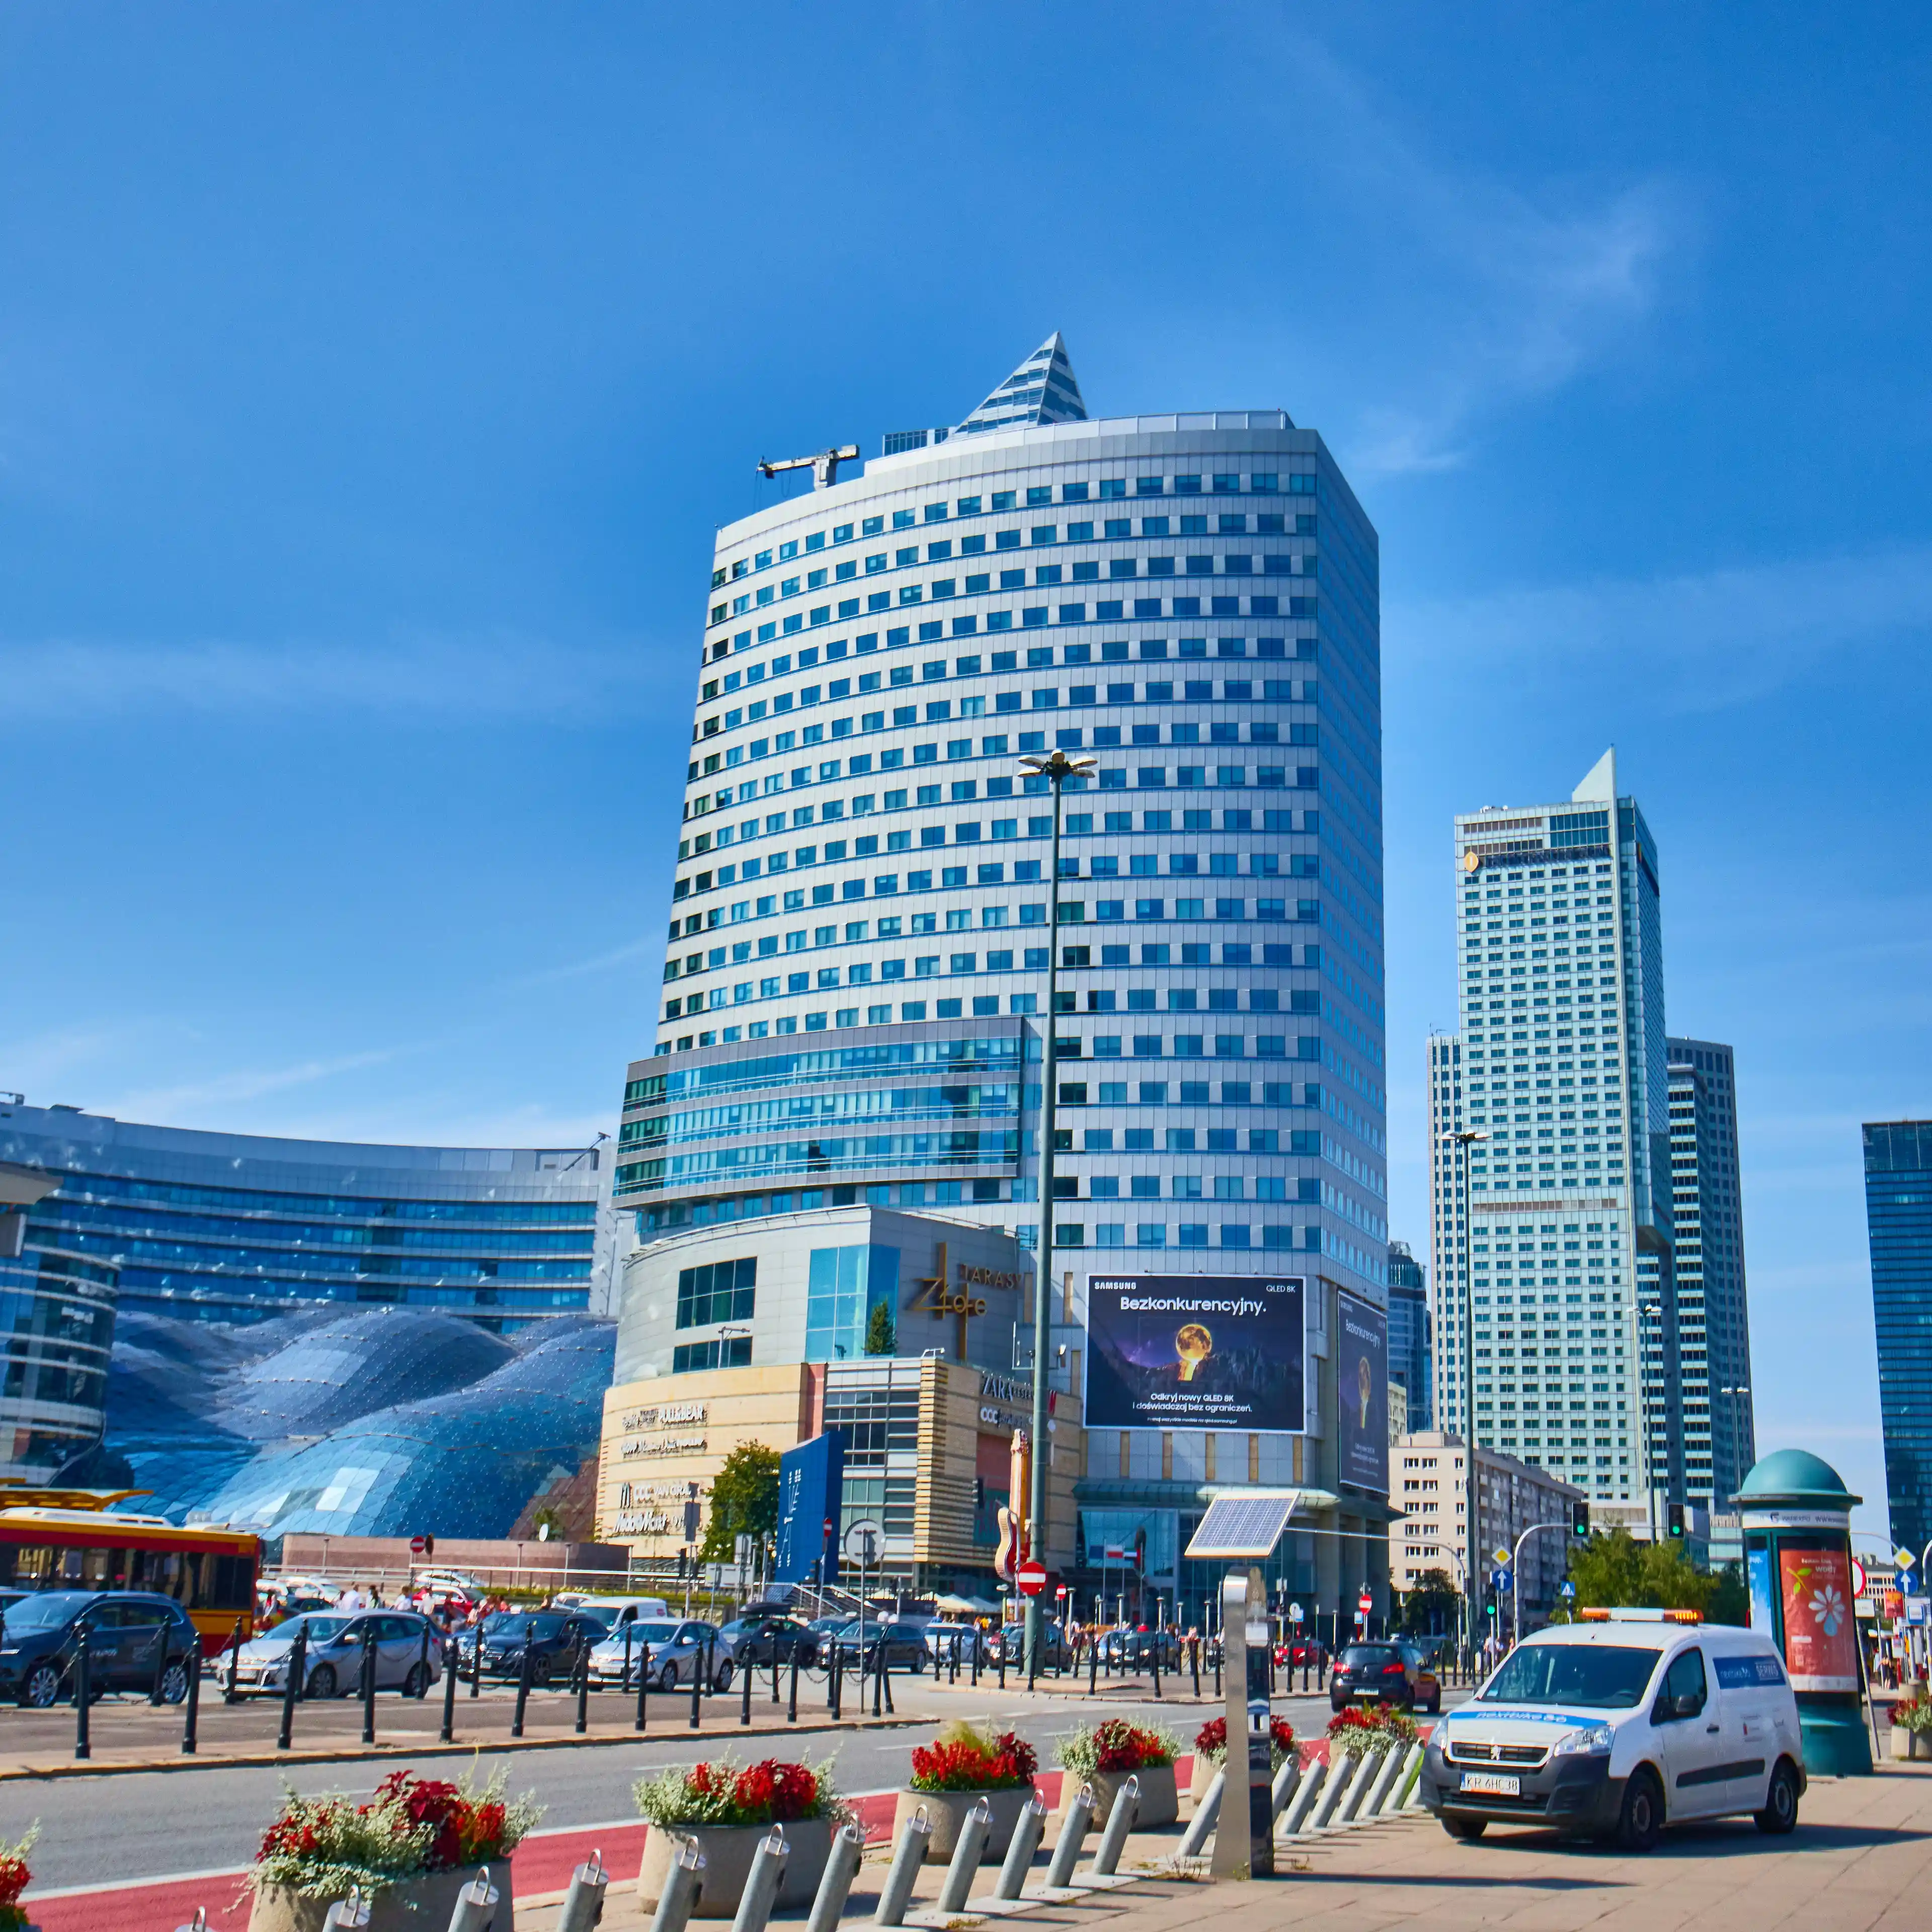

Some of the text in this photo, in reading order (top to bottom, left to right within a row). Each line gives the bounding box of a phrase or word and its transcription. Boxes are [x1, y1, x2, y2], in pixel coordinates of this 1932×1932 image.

[1094, 1281, 1137, 1290] SAMSUNG
[1121, 1297, 1266, 1316] Bezkonkurencyjny.
[983, 1376, 1013, 1402] ZARA
[1151, 1393, 1178, 1402] Odkryj
[1136, 1402, 1187, 1412] doświadczaj
[1205, 1404, 1252, 1413] ograniczeń.
[981, 1407, 998, 1423] CCC
[1467, 1777, 1517, 1791] KR 6HC38
